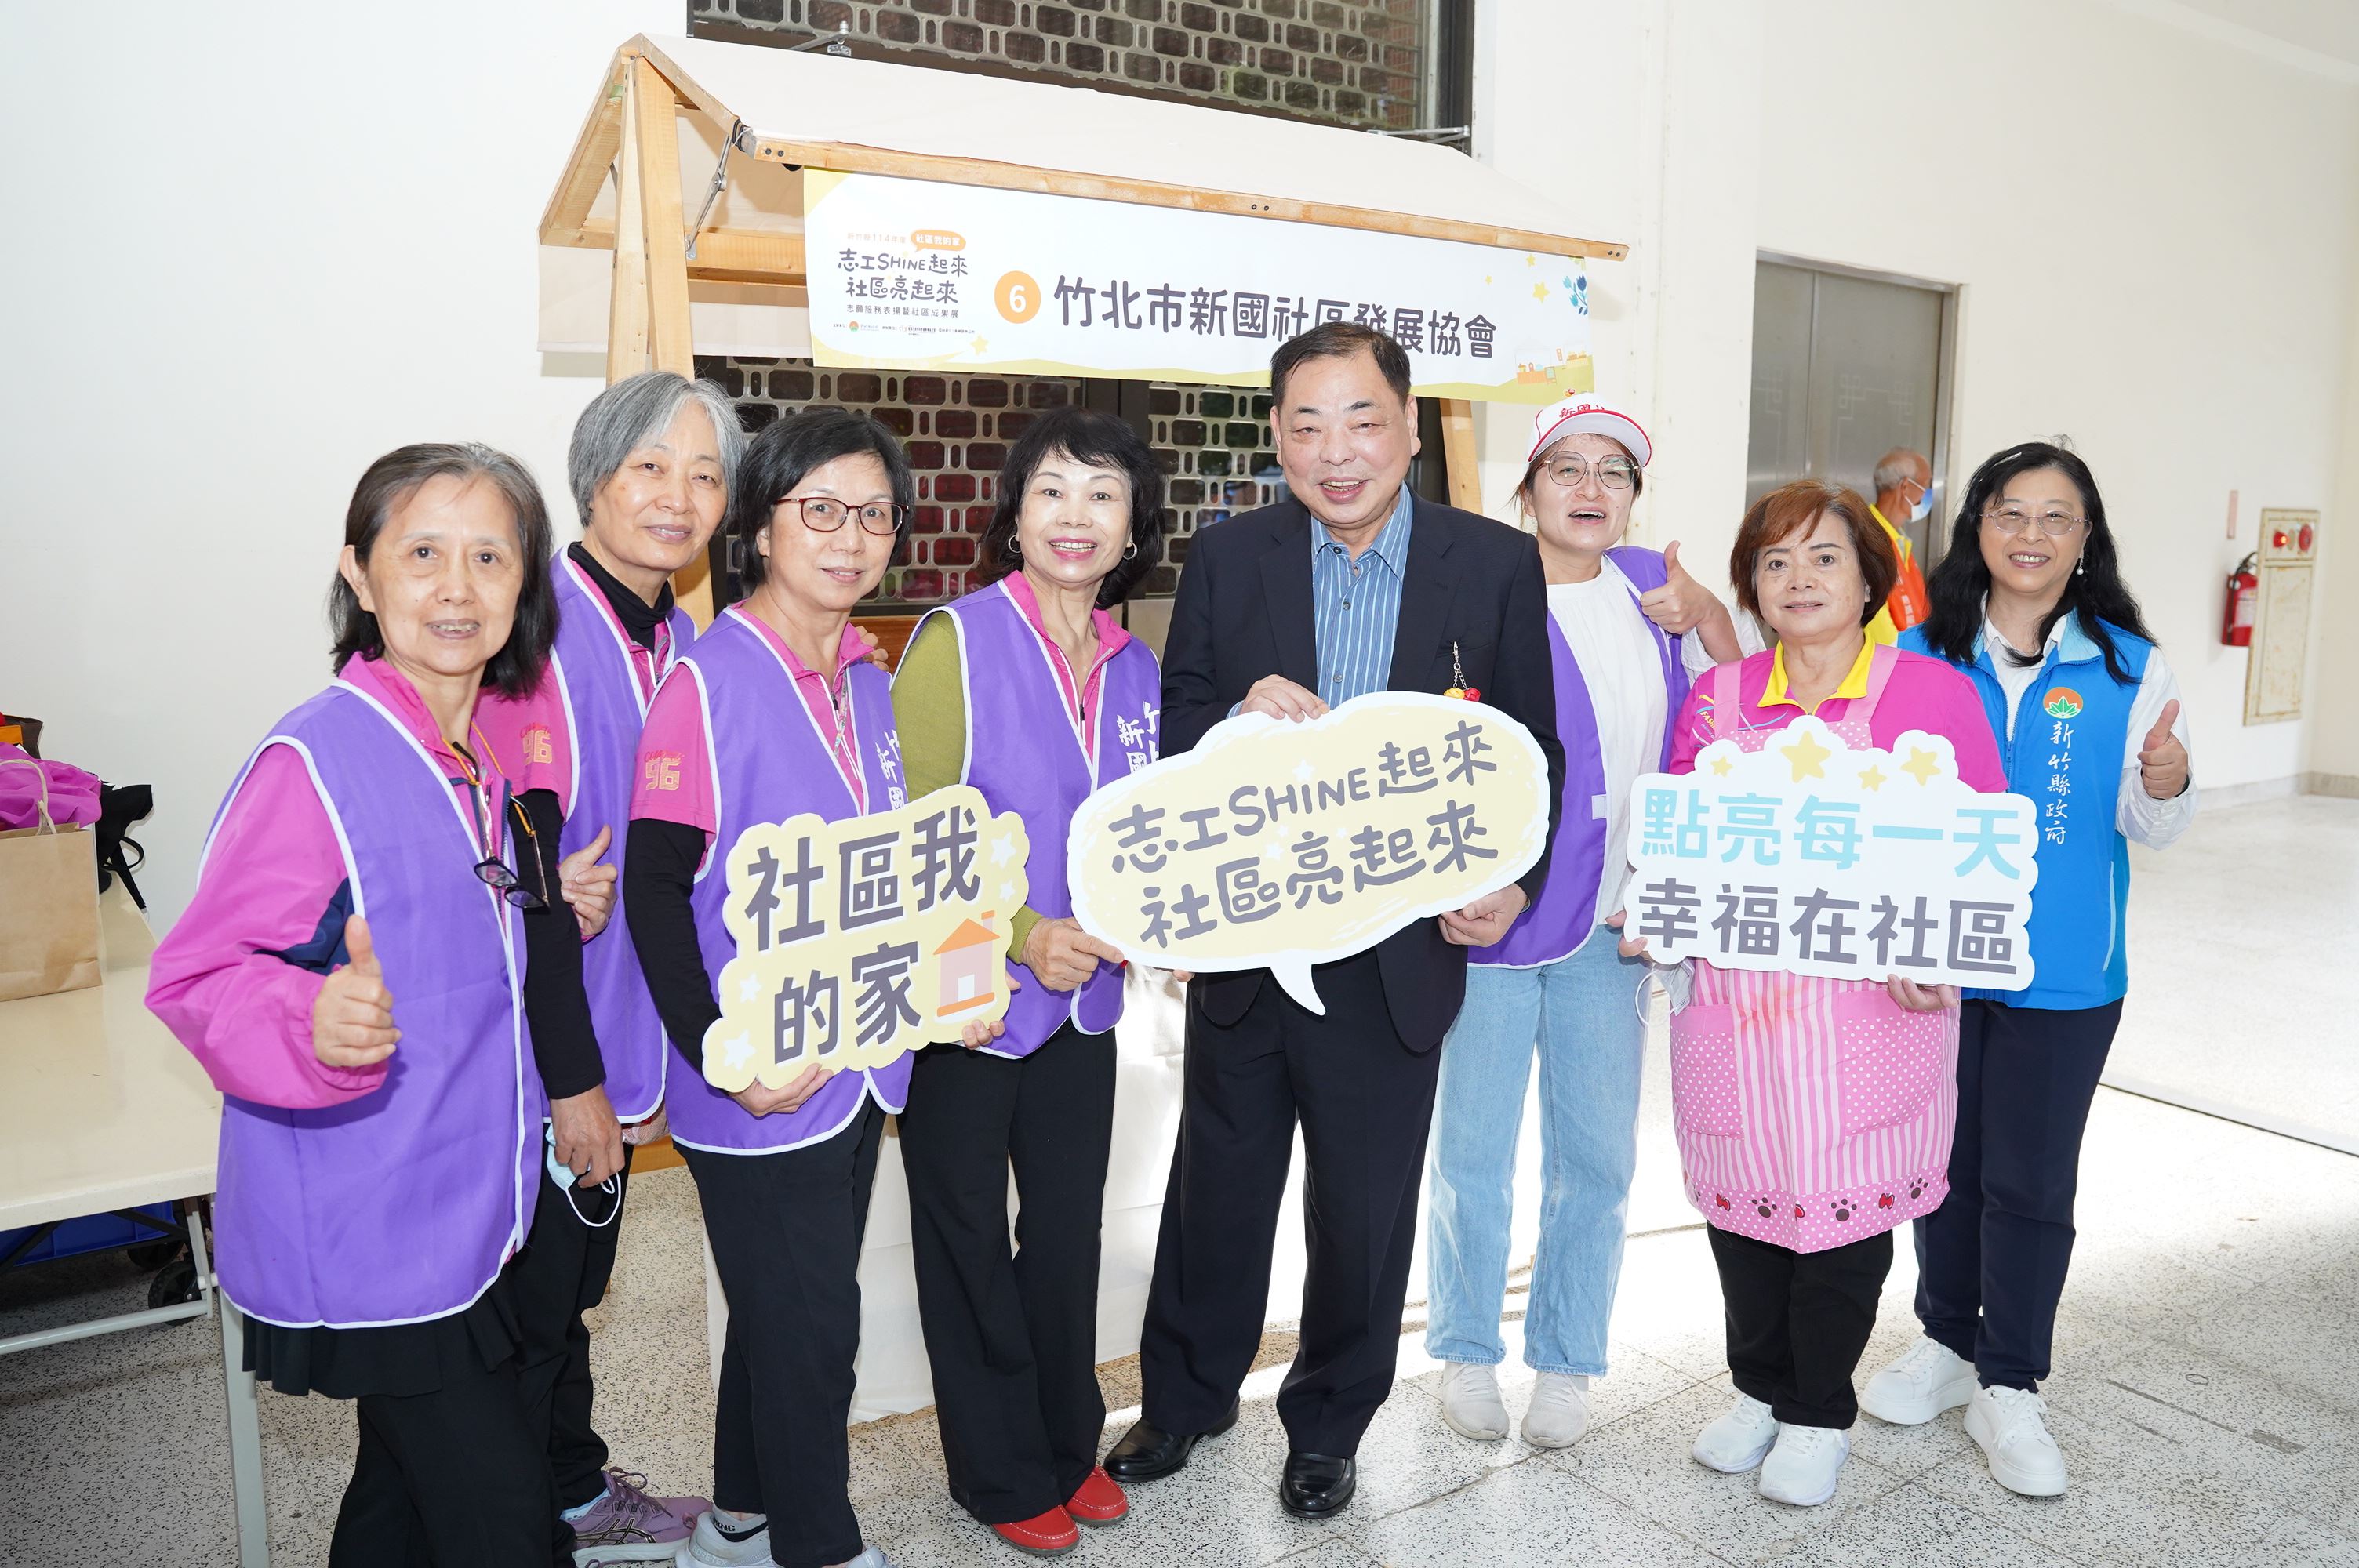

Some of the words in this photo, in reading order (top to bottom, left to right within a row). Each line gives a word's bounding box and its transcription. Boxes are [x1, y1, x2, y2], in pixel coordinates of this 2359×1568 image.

[838, 248, 969, 278] 志工SHINE起來
[845, 275, 959, 304] 社區亮起來
[1008, 284, 1027, 314] 6
[645, 757, 681, 791] 96
[1107, 720, 1497, 873] 志工SHINE起來
[2045, 720, 2074, 845] 新竹縣政府
[745, 805, 980, 952] 社區我
[1140, 799, 1499, 949] 社區亮起來
[1641, 789, 2021, 880] 點亮每一天
[1638, 877, 2017, 975] 幸福在社區
[774, 941, 921, 1065] 的家
